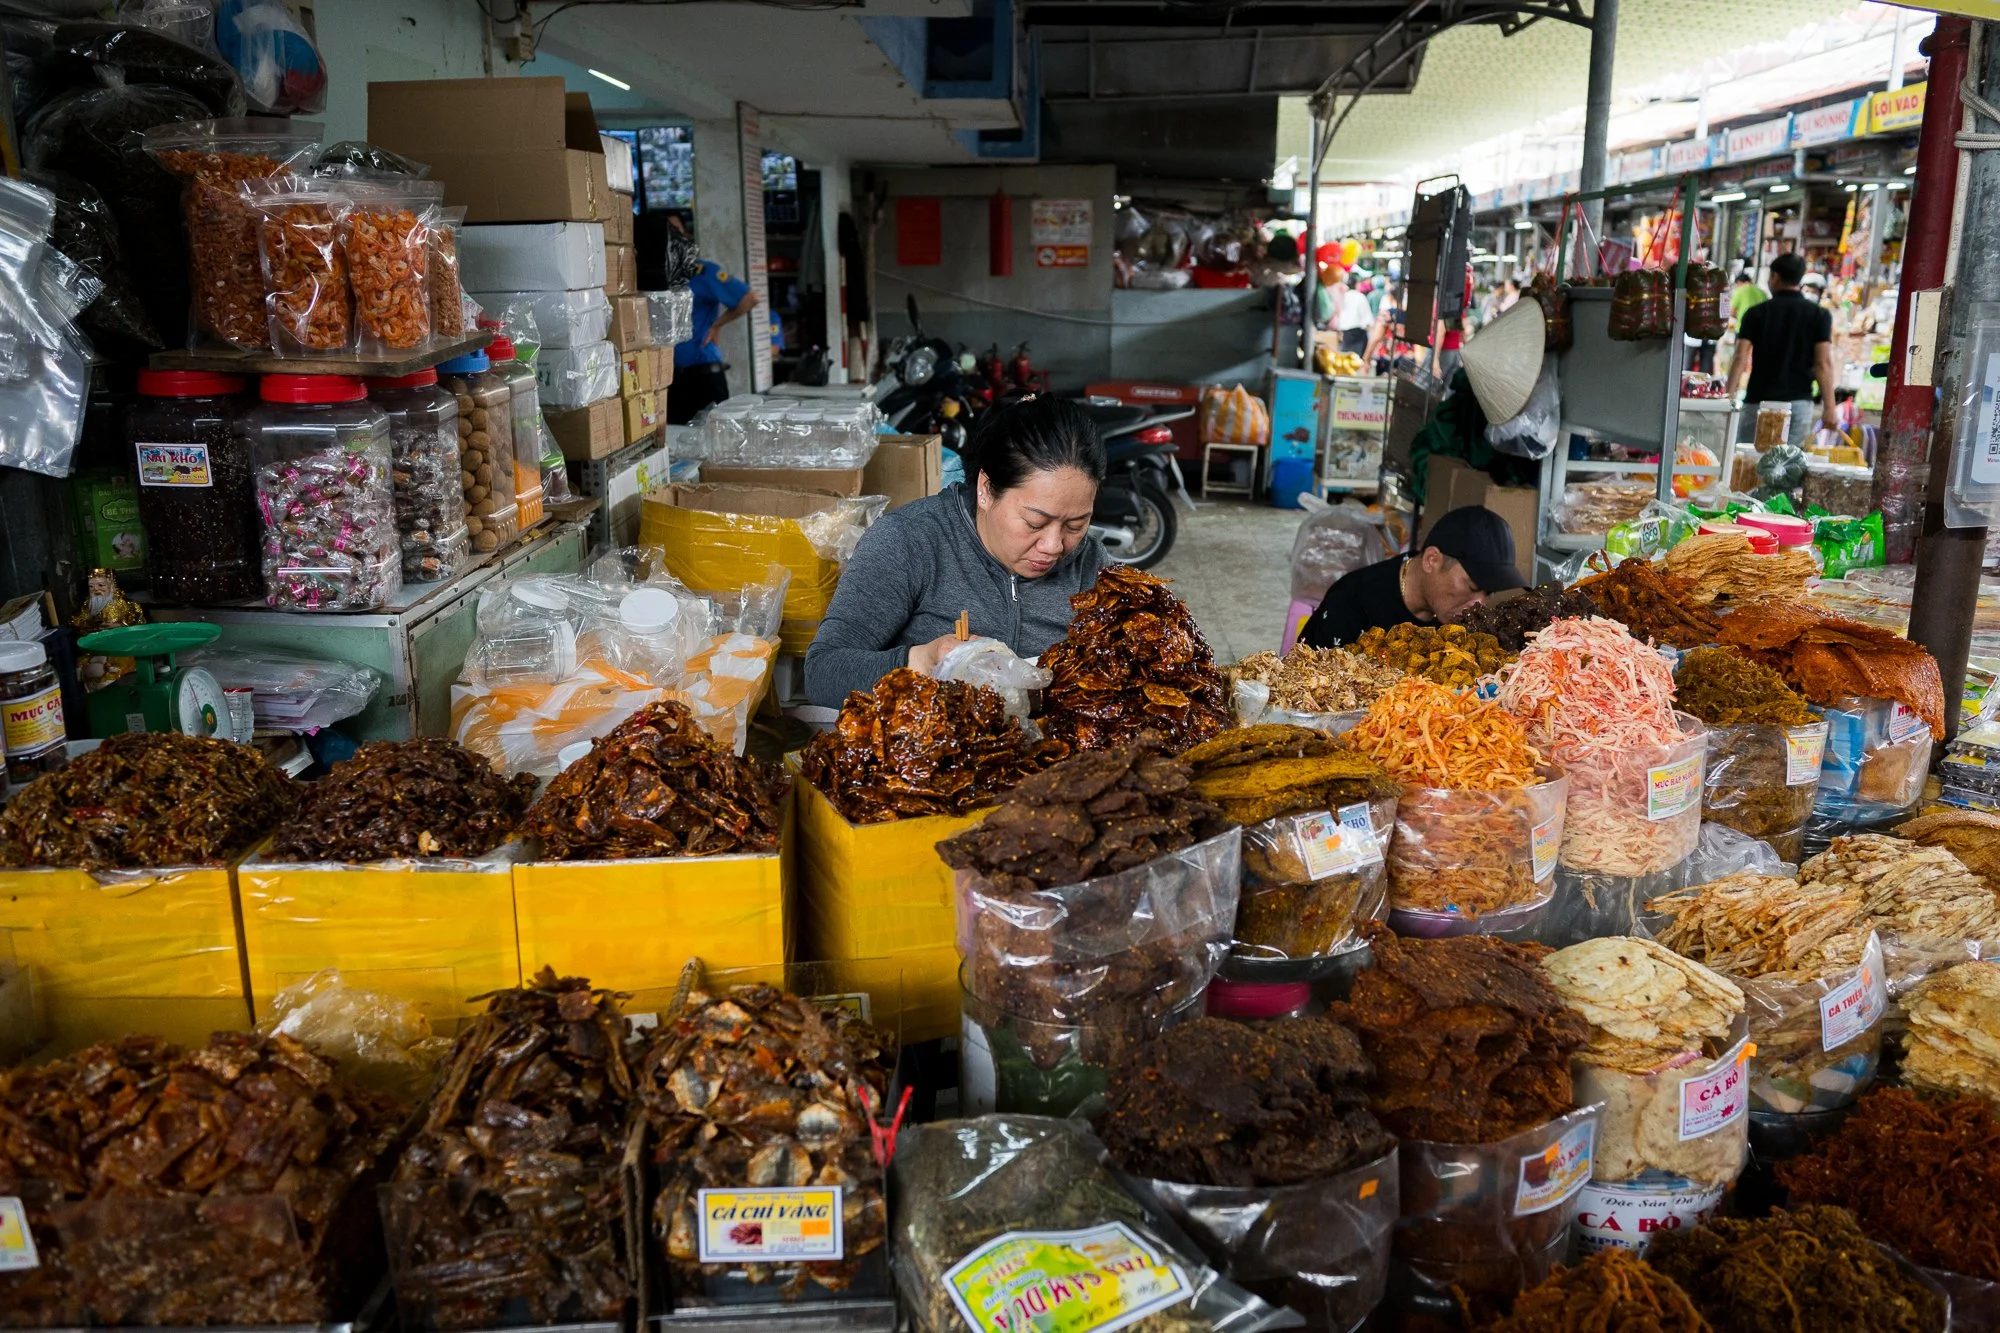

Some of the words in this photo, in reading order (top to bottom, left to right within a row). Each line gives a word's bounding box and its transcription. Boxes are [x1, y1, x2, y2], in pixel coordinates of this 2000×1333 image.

[1699, 1081, 1722, 1102] CÁ
[1724, 1068, 1739, 1091] BÒ
[778, 1201, 830, 1219] VÀNG
[1577, 1210, 1623, 1232] CÁ
[1638, 1210, 1681, 1233] BÒ
